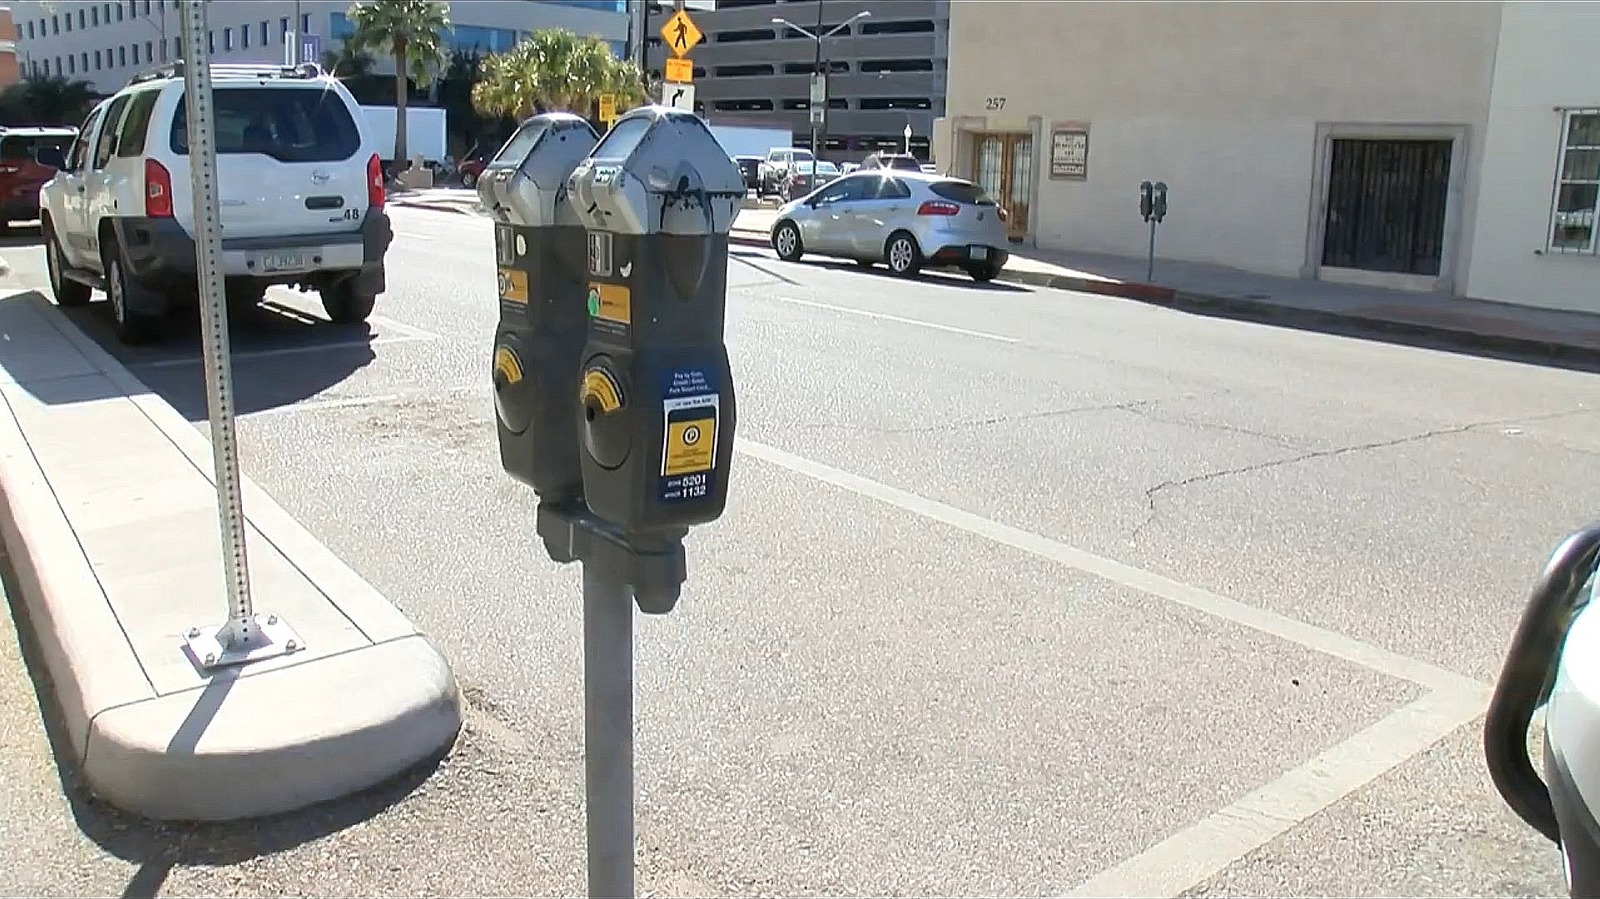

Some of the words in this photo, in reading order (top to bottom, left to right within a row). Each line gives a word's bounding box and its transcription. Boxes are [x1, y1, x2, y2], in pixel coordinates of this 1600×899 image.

[985, 97, 1006, 110] 257
[344, 207, 360, 220] 48
[682, 474, 706, 488] 5201
[682, 485, 706, 499] 1132
